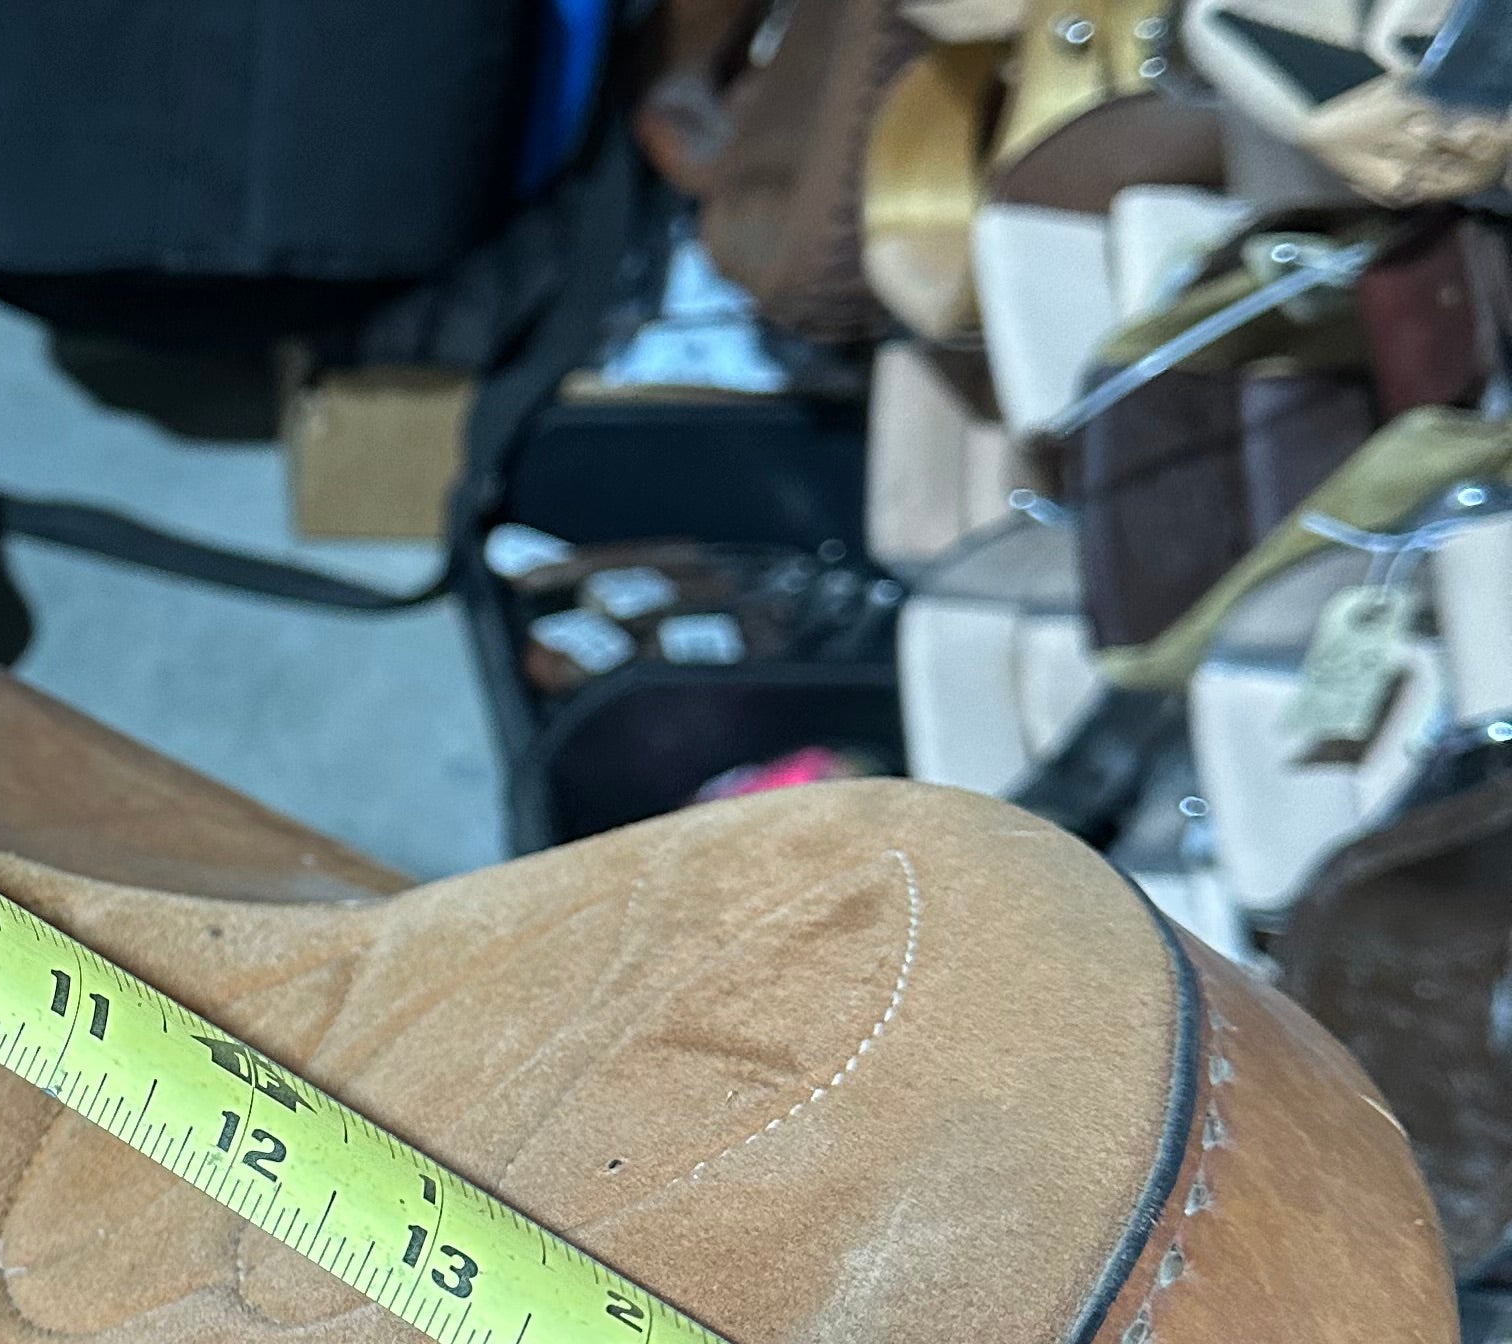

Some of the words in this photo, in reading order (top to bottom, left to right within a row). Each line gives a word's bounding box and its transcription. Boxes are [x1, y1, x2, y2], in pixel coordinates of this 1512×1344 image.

[50, 968, 110, 1041] 11
[218, 1110, 287, 1183] 12
[419, 1173, 437, 1205] 1
[402, 1224, 479, 1298] 13
[606, 1290, 645, 1333] 2
